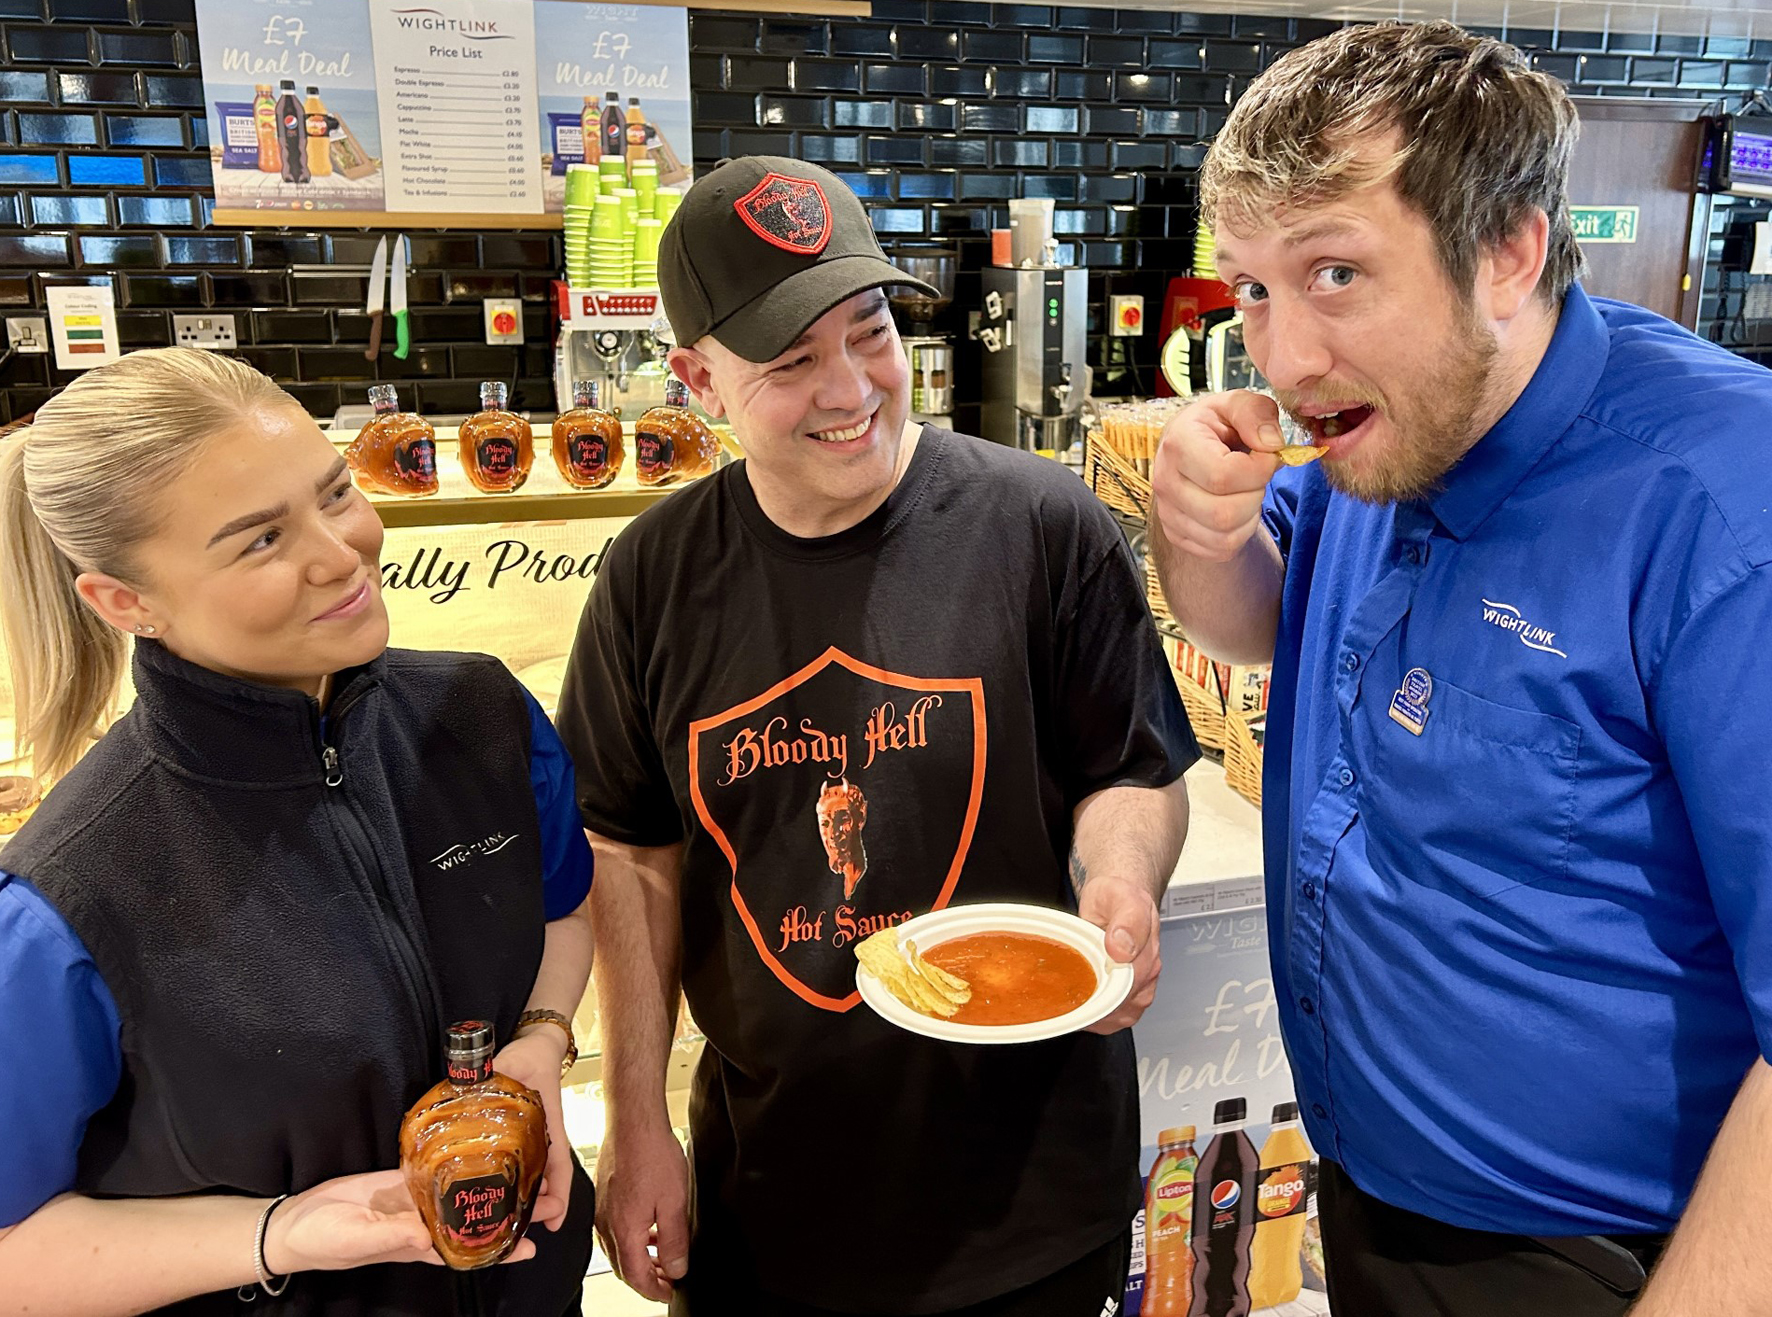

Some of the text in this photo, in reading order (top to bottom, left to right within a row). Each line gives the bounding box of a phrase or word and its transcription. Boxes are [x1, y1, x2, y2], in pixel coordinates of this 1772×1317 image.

[262, 14, 308, 46] £7
[397, 16, 498, 33] WIGHTLINK
[429, 45, 483, 59] Price List
[592, 30, 632, 60] £7
[222, 47, 353, 77] Meal Deal
[394, 66, 421, 74] Espresso
[555, 62, 671, 89] Meal Deal
[395, 79, 417, 87] Double
[418, 80, 445, 88] Espresso
[396, 91, 429, 99] Americano
[397, 103, 432, 112] Cappuccino
[399, 128, 419, 136] Mocha
[431, 166, 448, 174] Syrup
[416, 177, 446, 185] Chocolate
[485, 443, 512, 455] Bloody
[577, 440, 603, 452] Bloody
[490, 454, 506, 464] Hell
[582, 450, 597, 460] Hell
[1482, 607, 1556, 646] WIGHTLINK
[717, 695, 943, 786] Bloody Hell
[778, 905, 827, 953] Hot
[1231, 936, 1262, 950] Taste
[1203, 979, 1277, 1037] £7
[1159, 1184, 1192, 1197] Lipton
[1258, 1179, 1304, 1200] Tango
[453, 1185, 505, 1209] Bloody
[463, 1199, 499, 1226] Hell
[1152, 1226, 1180, 1237] PEACH
